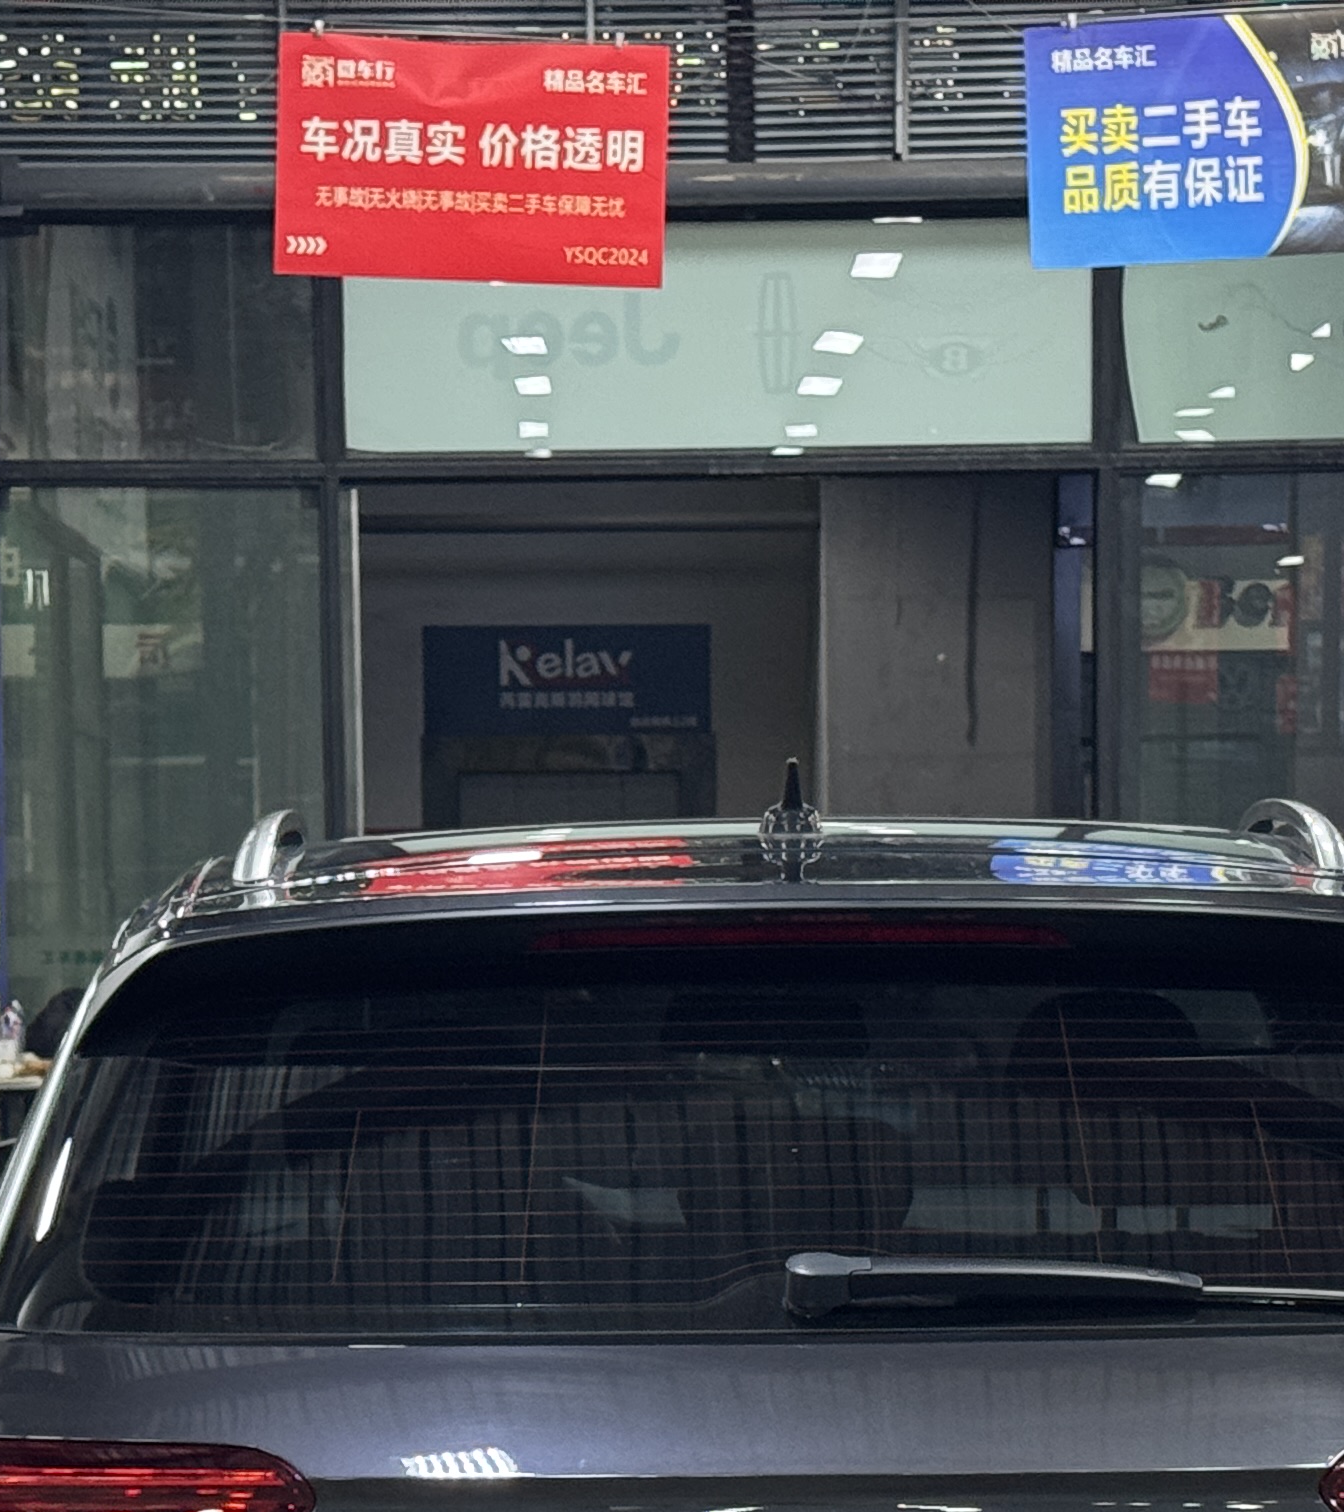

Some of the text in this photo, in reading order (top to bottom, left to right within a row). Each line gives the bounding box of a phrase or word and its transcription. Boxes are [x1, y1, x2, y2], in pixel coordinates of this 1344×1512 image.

[1051, 44, 1156, 73] 精品名车汇
[543, 68, 648, 95] 精品名车汇
[299, 115, 645, 173] 车况真实 价格透明
[1059, 96, 1263, 157] 买卖二手车
[1062, 156, 1265, 214] 品质有保证
[562, 245, 649, 267] YSQC2024
